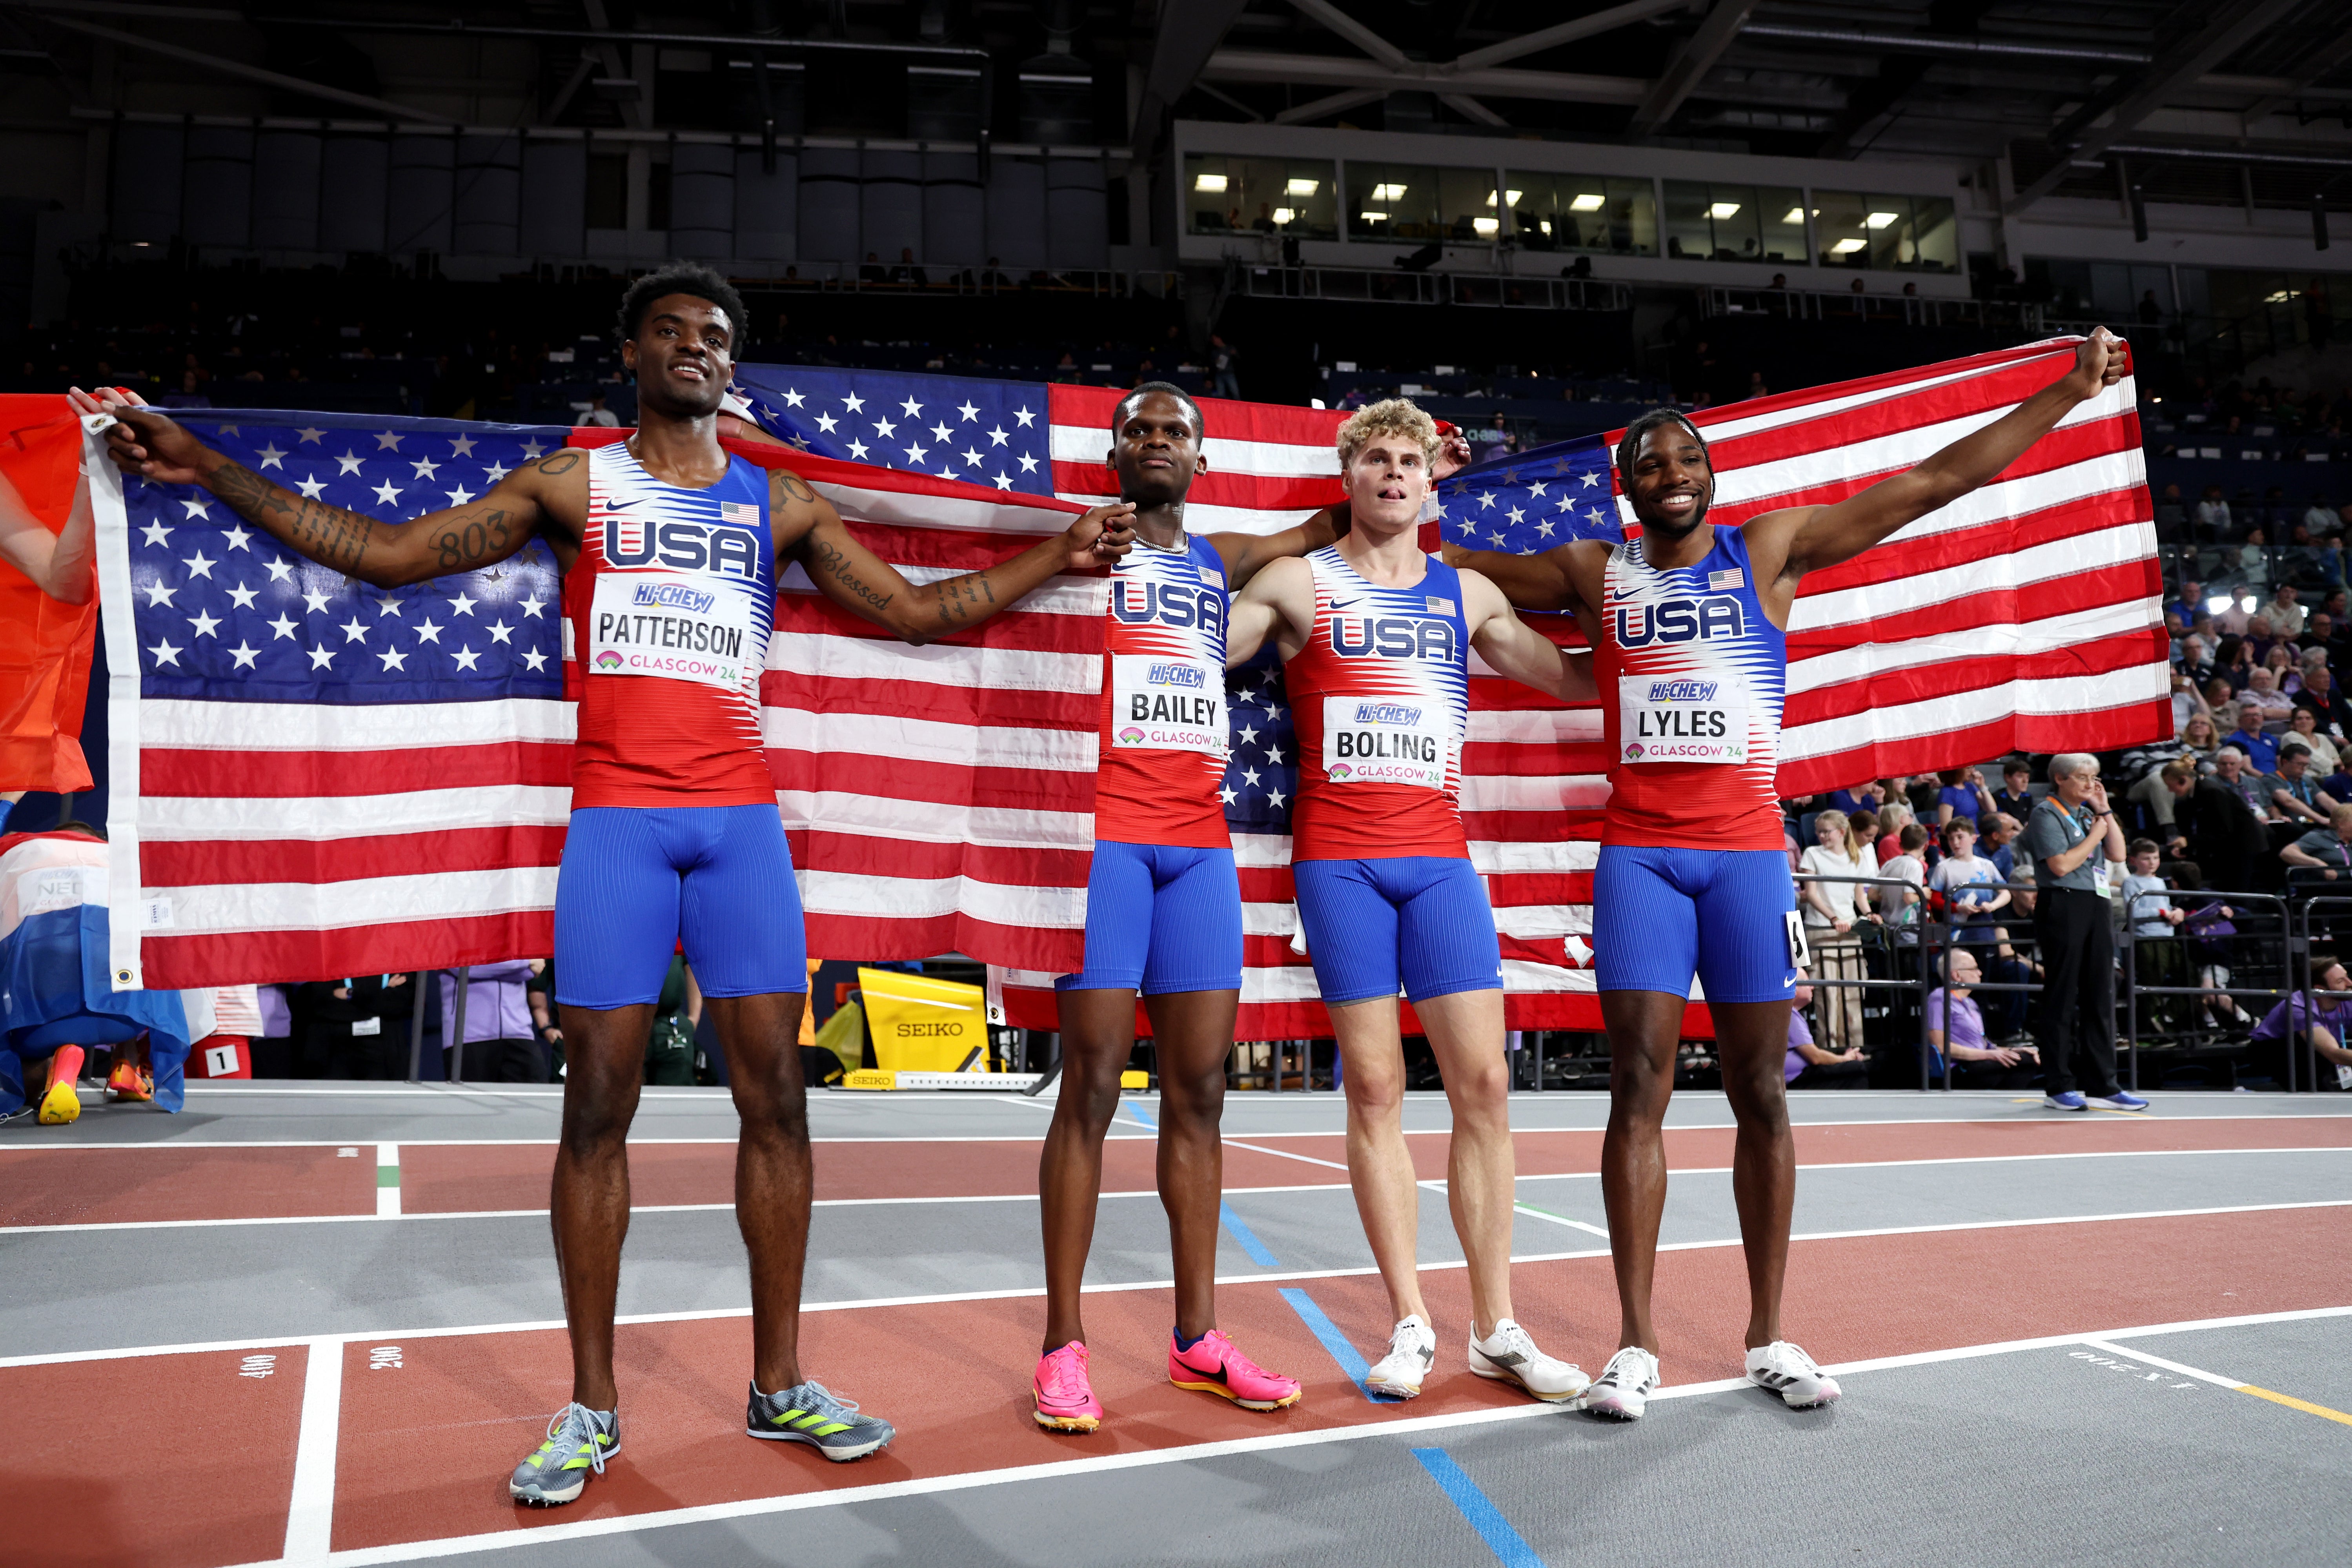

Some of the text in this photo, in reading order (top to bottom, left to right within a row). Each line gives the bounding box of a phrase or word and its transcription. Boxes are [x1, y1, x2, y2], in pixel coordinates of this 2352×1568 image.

[439, 510, 509, 569] 803
[603, 519, 759, 582] USA
[819, 542, 893, 610] Blessed
[632, 583, 715, 614] HI-CHEW
[1111, 579, 1224, 640] USA
[1615, 594, 1746, 650] USA
[599, 613, 742, 658] PATTERSON
[1330, 615, 1456, 664] USA
[630, 655, 736, 681] GLASGOW 24
[1147, 663, 1205, 689] HI-CHEW
[1647, 680, 1718, 702] HI-CHEW
[1132, 694, 1216, 727] BAILEY
[1354, 703, 1422, 727] HI-CHEW
[1639, 711, 1726, 737] LYLES
[1151, 730, 1222, 747] GLASGOW 24
[1338, 732, 1436, 763] BOLING
[1649, 745, 1742, 757] GLASGOW 24
[1357, 765, 1440, 782] GLASGOW 24
[897, 1023, 963, 1037] SEIKO
[216, 1052, 226, 1069] 1
[852, 1076, 891, 1086] SEIKO
[238, 1354, 277, 1379] 400
[369, 1346, 403, 1370] 200
